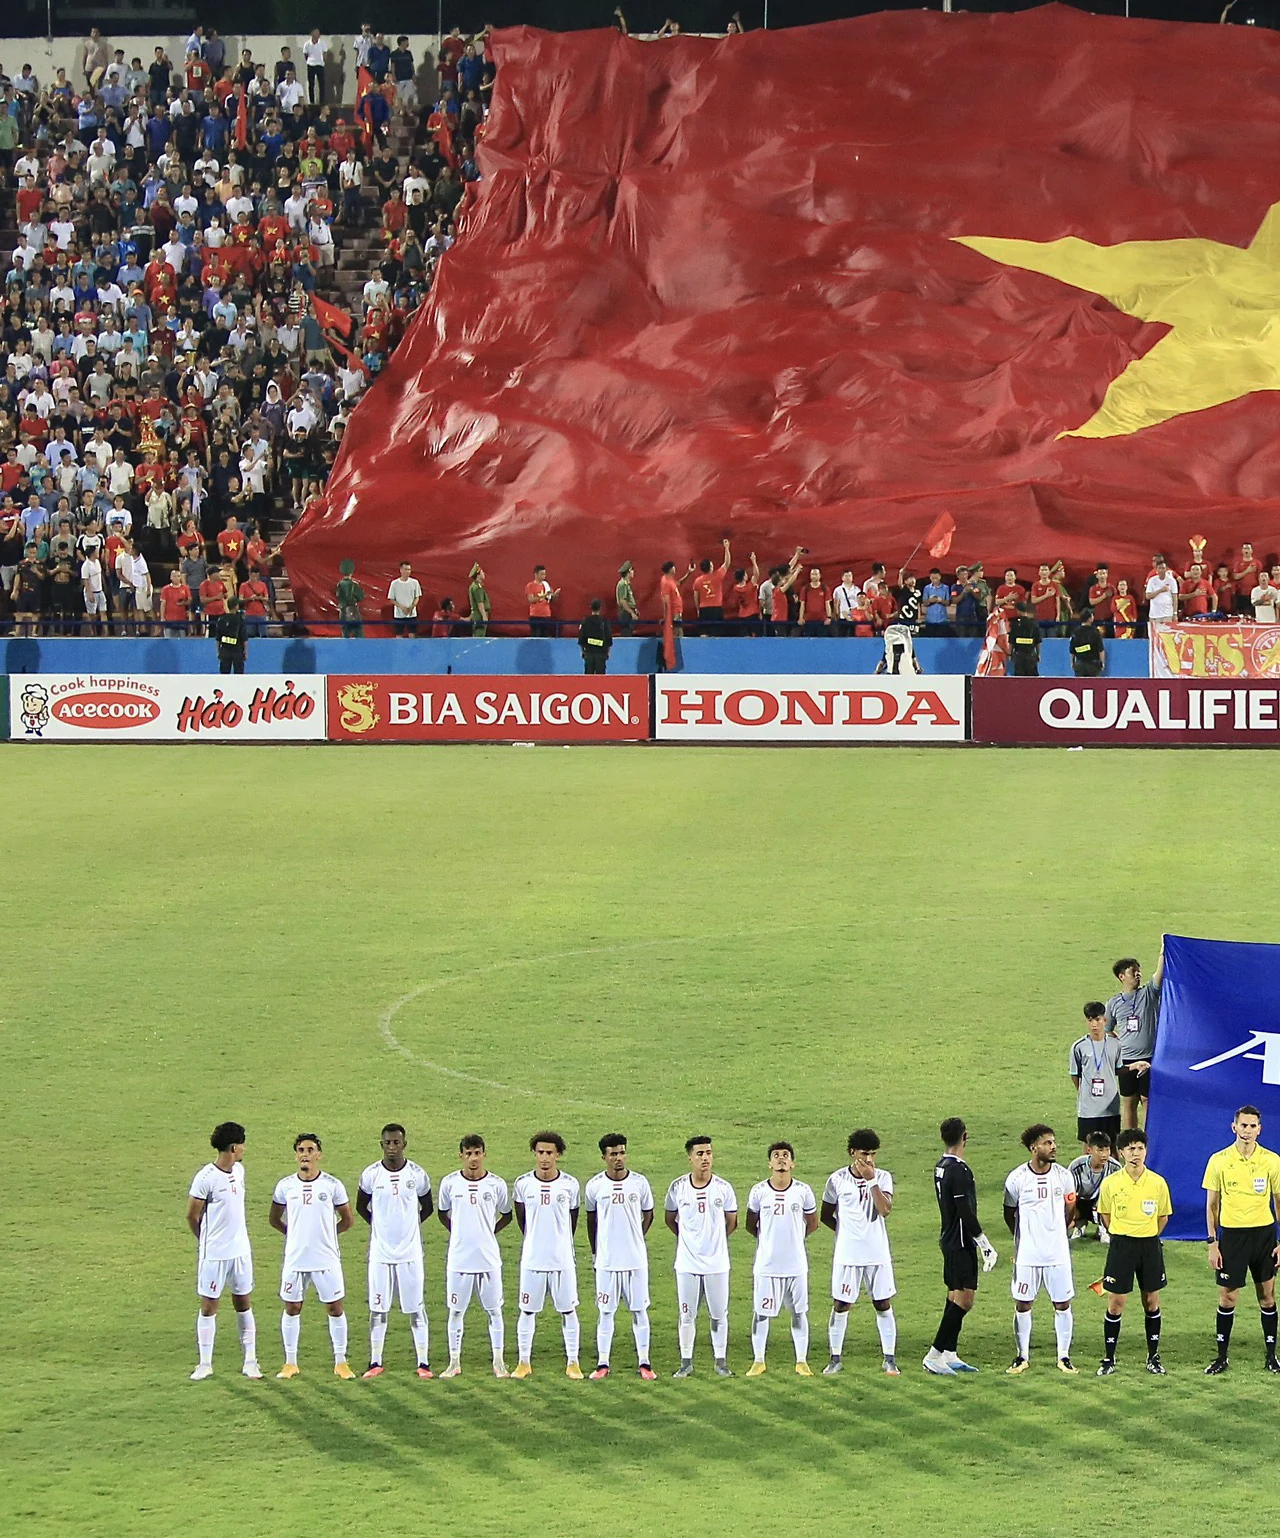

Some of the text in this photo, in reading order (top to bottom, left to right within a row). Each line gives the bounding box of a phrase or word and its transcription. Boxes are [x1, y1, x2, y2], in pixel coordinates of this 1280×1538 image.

[50, 675, 161, 697] Cook happiness
[177, 680, 316, 733] Hảo Hảo
[388, 691, 631, 725] BIA SAIGON
[660, 689, 960, 726] HONDA
[231, 1184, 237, 1195] 4
[392, 1183, 399, 1196] 3
[1036, 1187, 1048, 1199] 10
[302, 1193, 313, 1205] 12
[469, 1192, 477, 1205] 6
[540, 1193, 551, 1206] 18
[611, 1192, 625, 1205] 20
[773, 1203, 785, 1216] 21
[210, 1280, 217, 1292] 4
[283, 1281, 293, 1294] 12
[841, 1283, 852, 1297] 14
[1017, 1282, 1029, 1295] 10
[375, 1293, 382, 1305] 3
[451, 1293, 458, 1305] 6
[597, 1291, 609, 1304] 20
[761, 1297, 773, 1310] 21
[681, 1302, 688, 1314] 8
